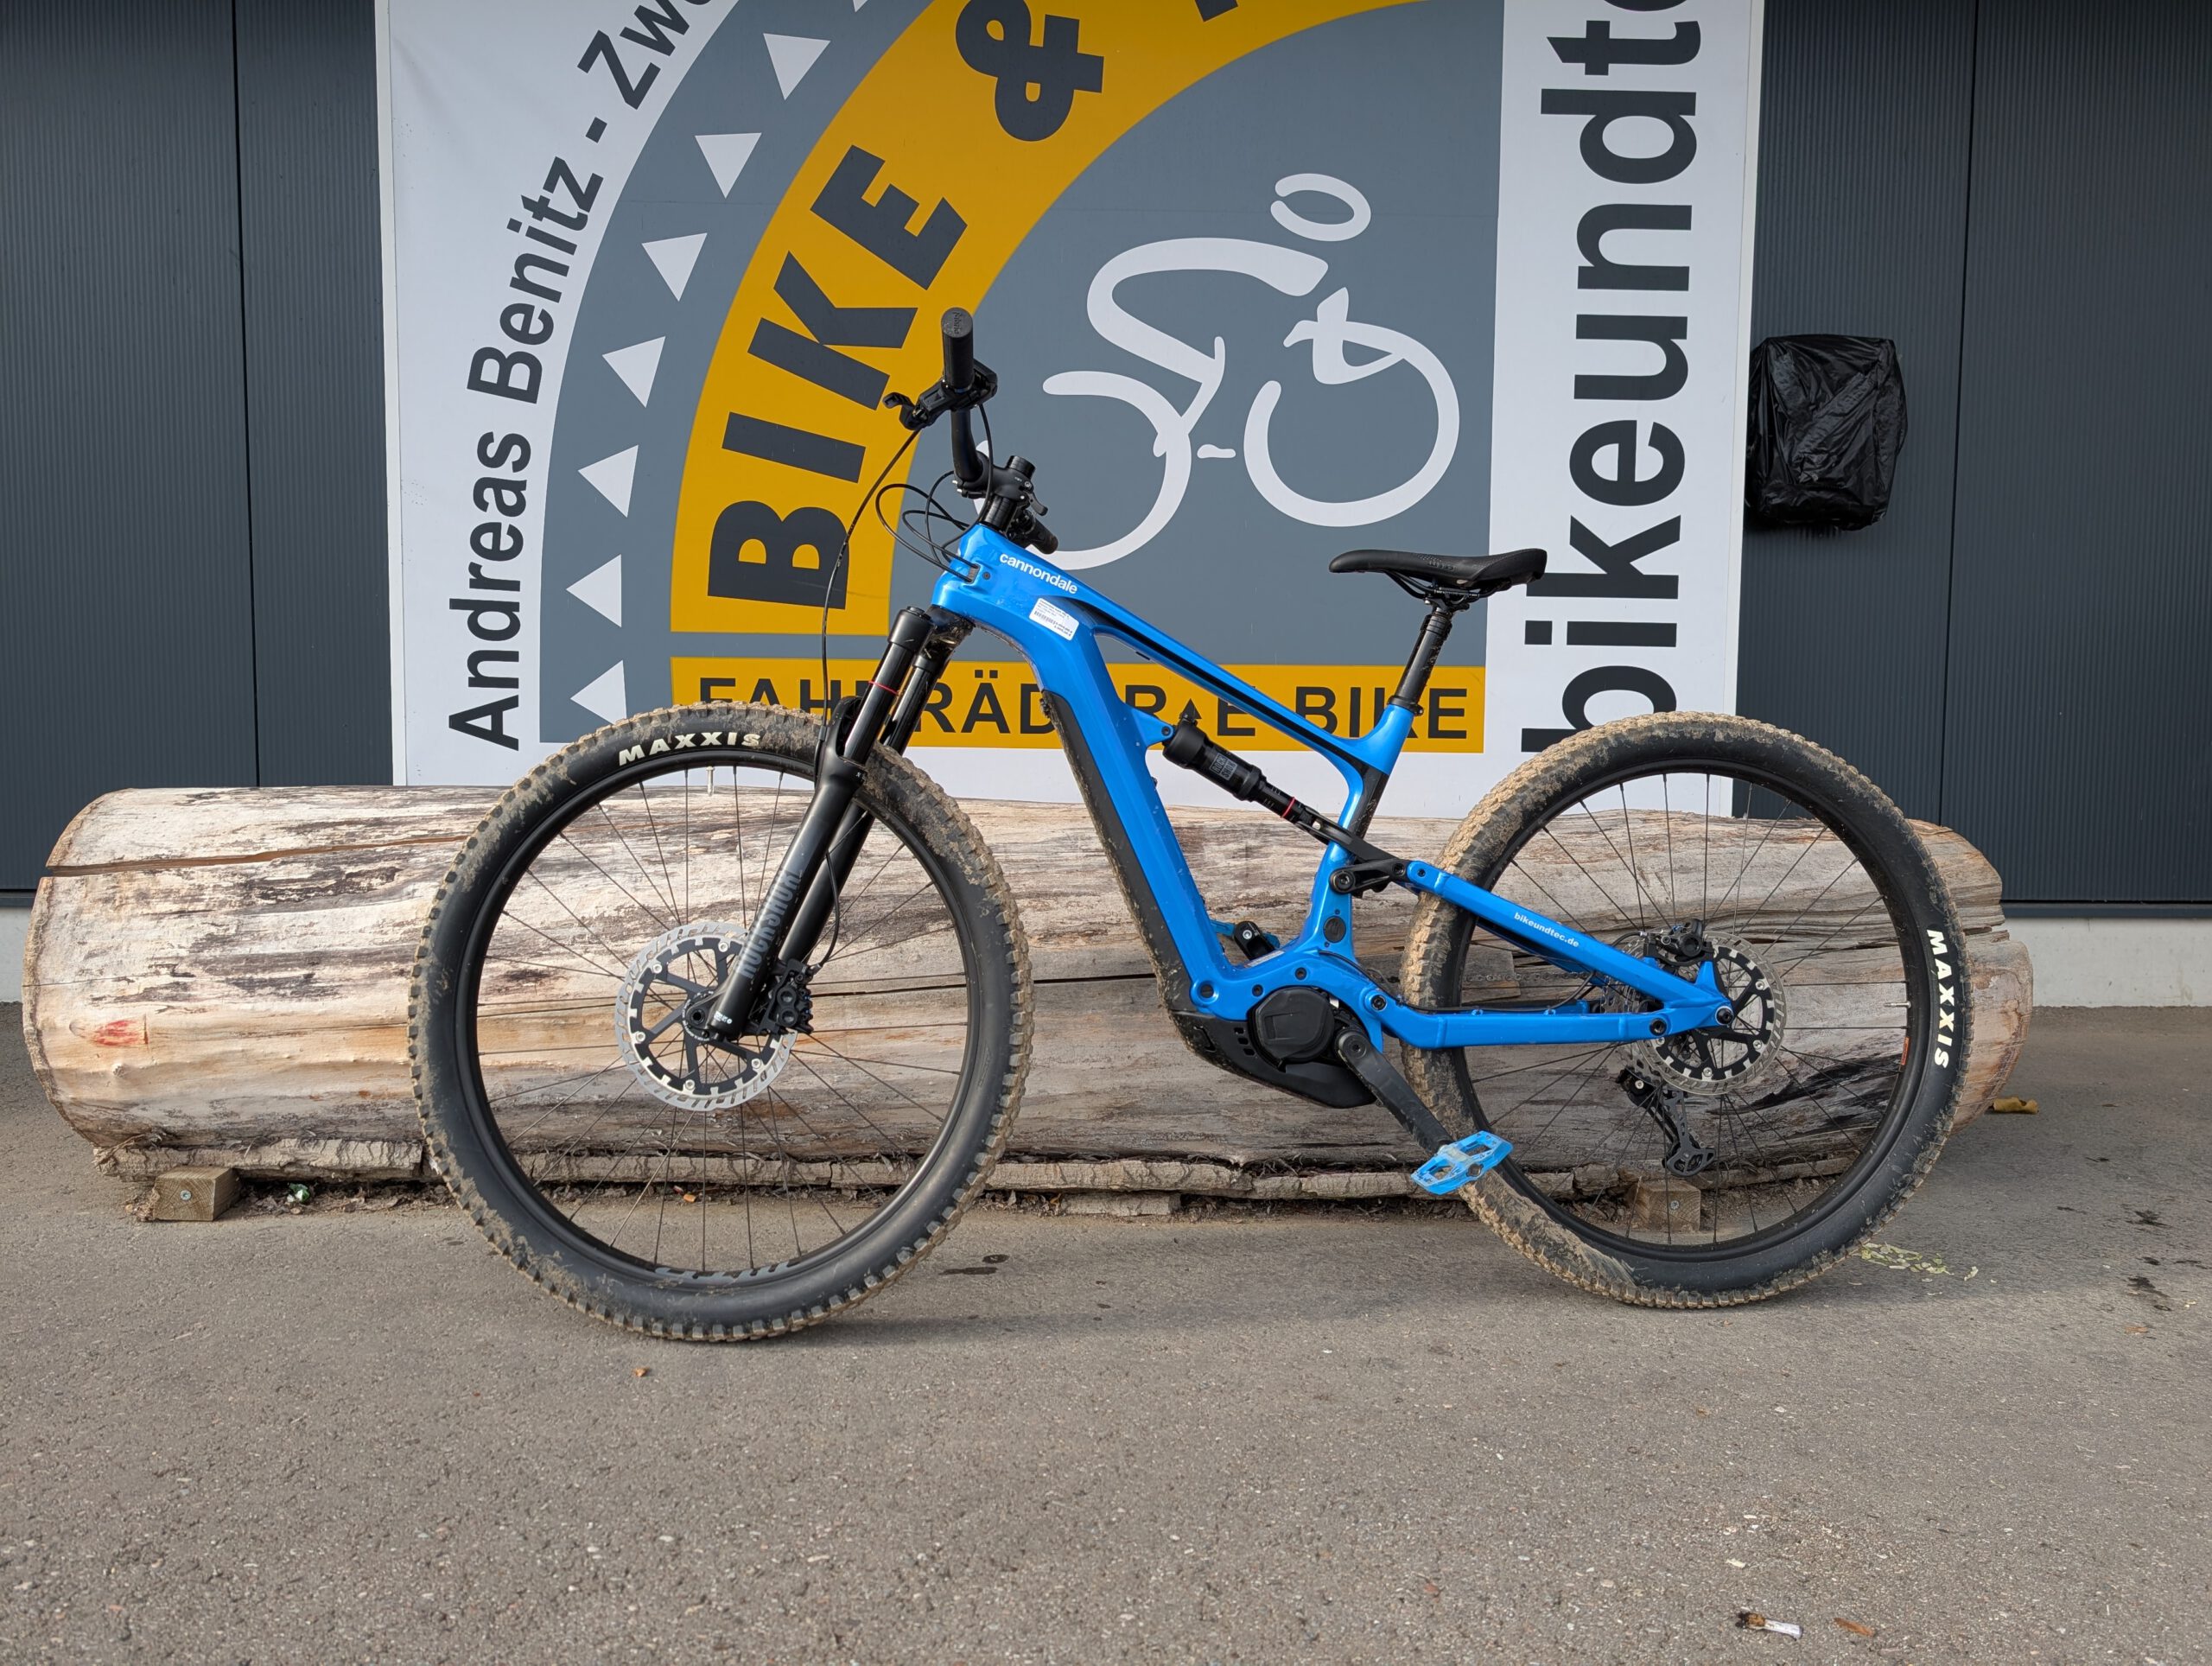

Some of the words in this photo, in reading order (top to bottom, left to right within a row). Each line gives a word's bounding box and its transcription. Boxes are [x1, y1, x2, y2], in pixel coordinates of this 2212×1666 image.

[577, 0, 713, 110] Zw
[467, 156, 603, 404] Benitz
[708, 144, 968, 610] BIKE
[956, 0, 1104, 142] &
[1521, 0, 1701, 753] bikeundt
[448, 431, 531, 752] Andreas
[999, 553, 1078, 595] cannondale
[619, 731, 761, 766] MAXXIS
[1514, 912, 1580, 948] bikeundtec.de
[1926, 929, 1955, 1069] MAXXIS
